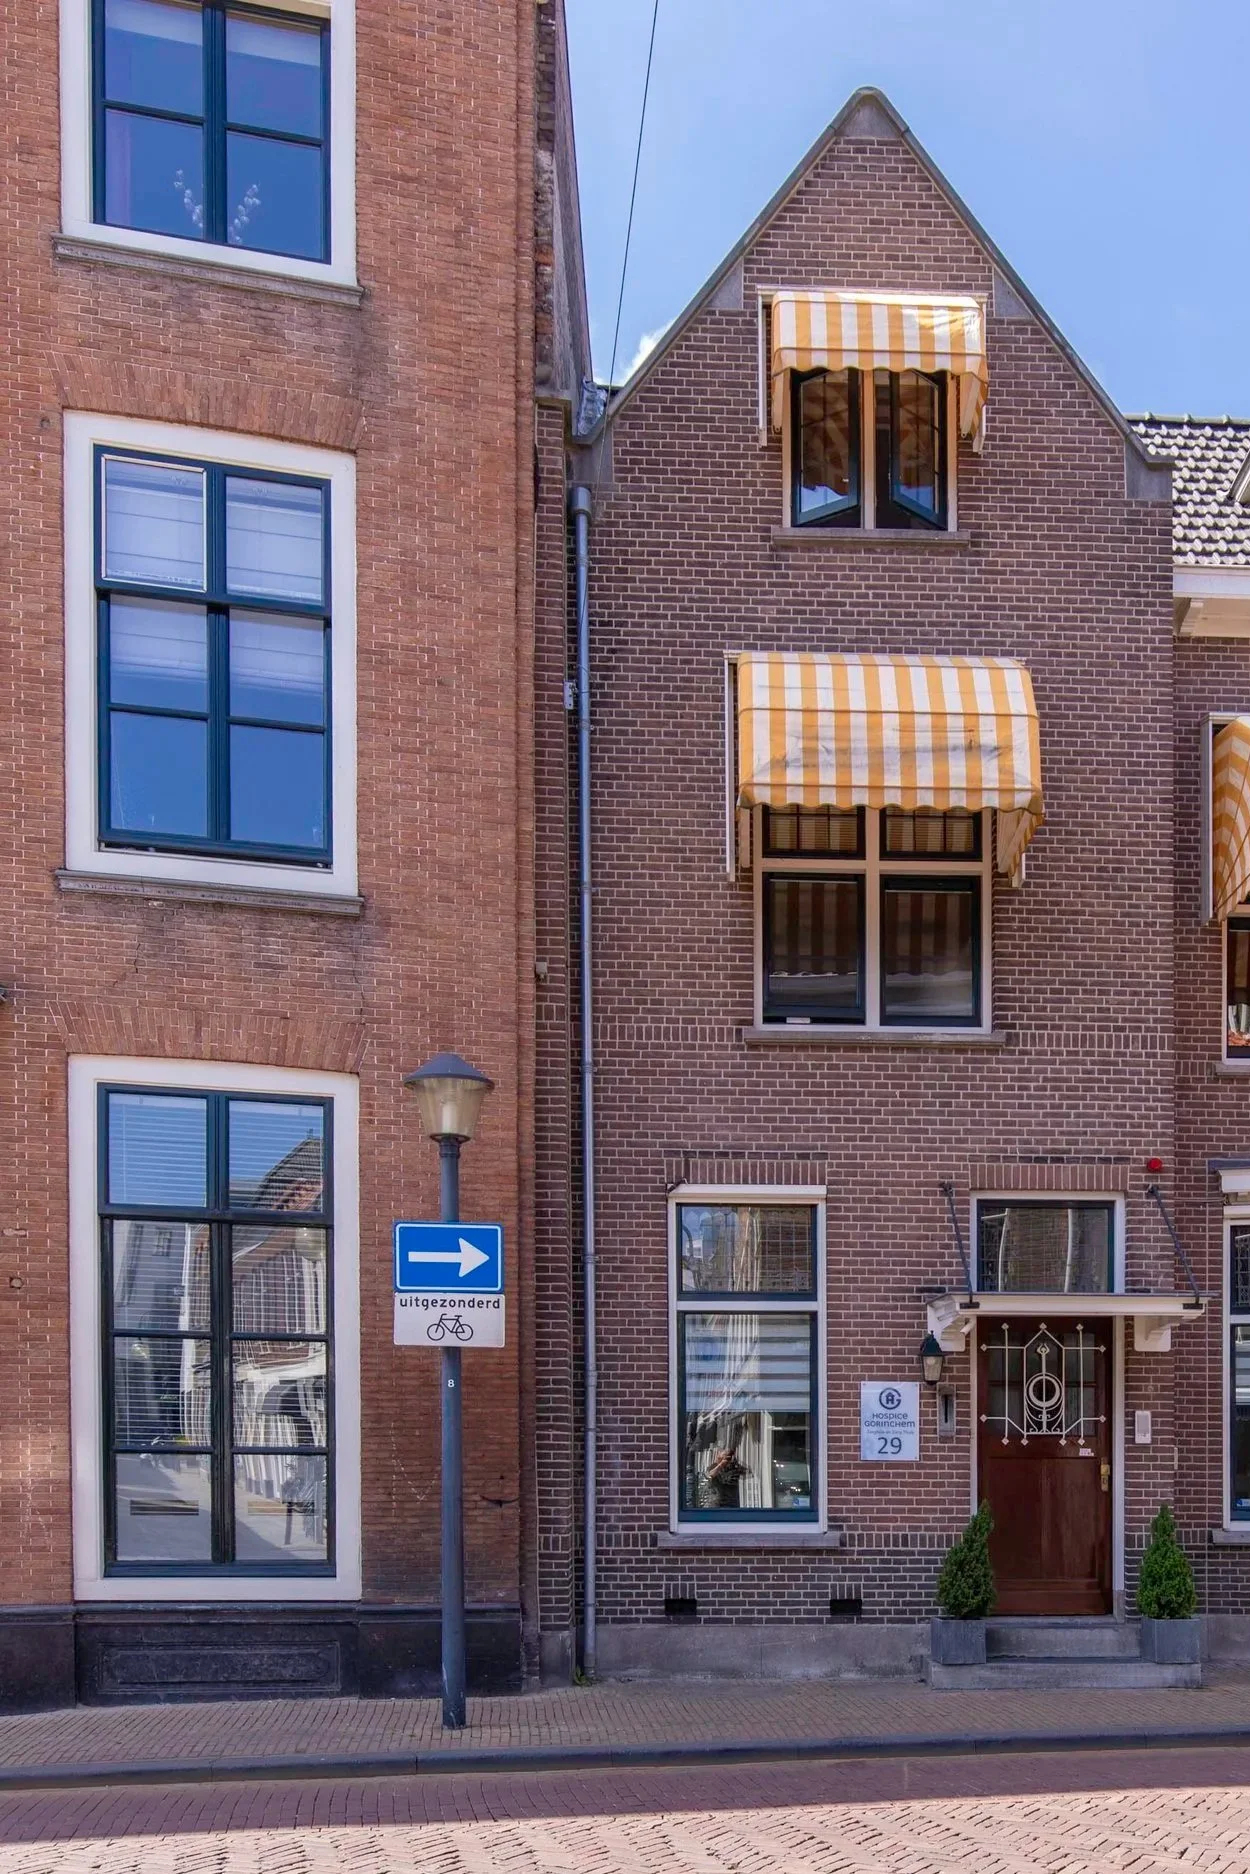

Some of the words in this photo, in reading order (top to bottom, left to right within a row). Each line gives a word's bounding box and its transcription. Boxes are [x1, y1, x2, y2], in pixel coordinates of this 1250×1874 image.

[399, 1296, 501, 1311] uitgezonderd
[447, 1379, 455, 1388] 8
[877, 1436, 903, 1455] 29
